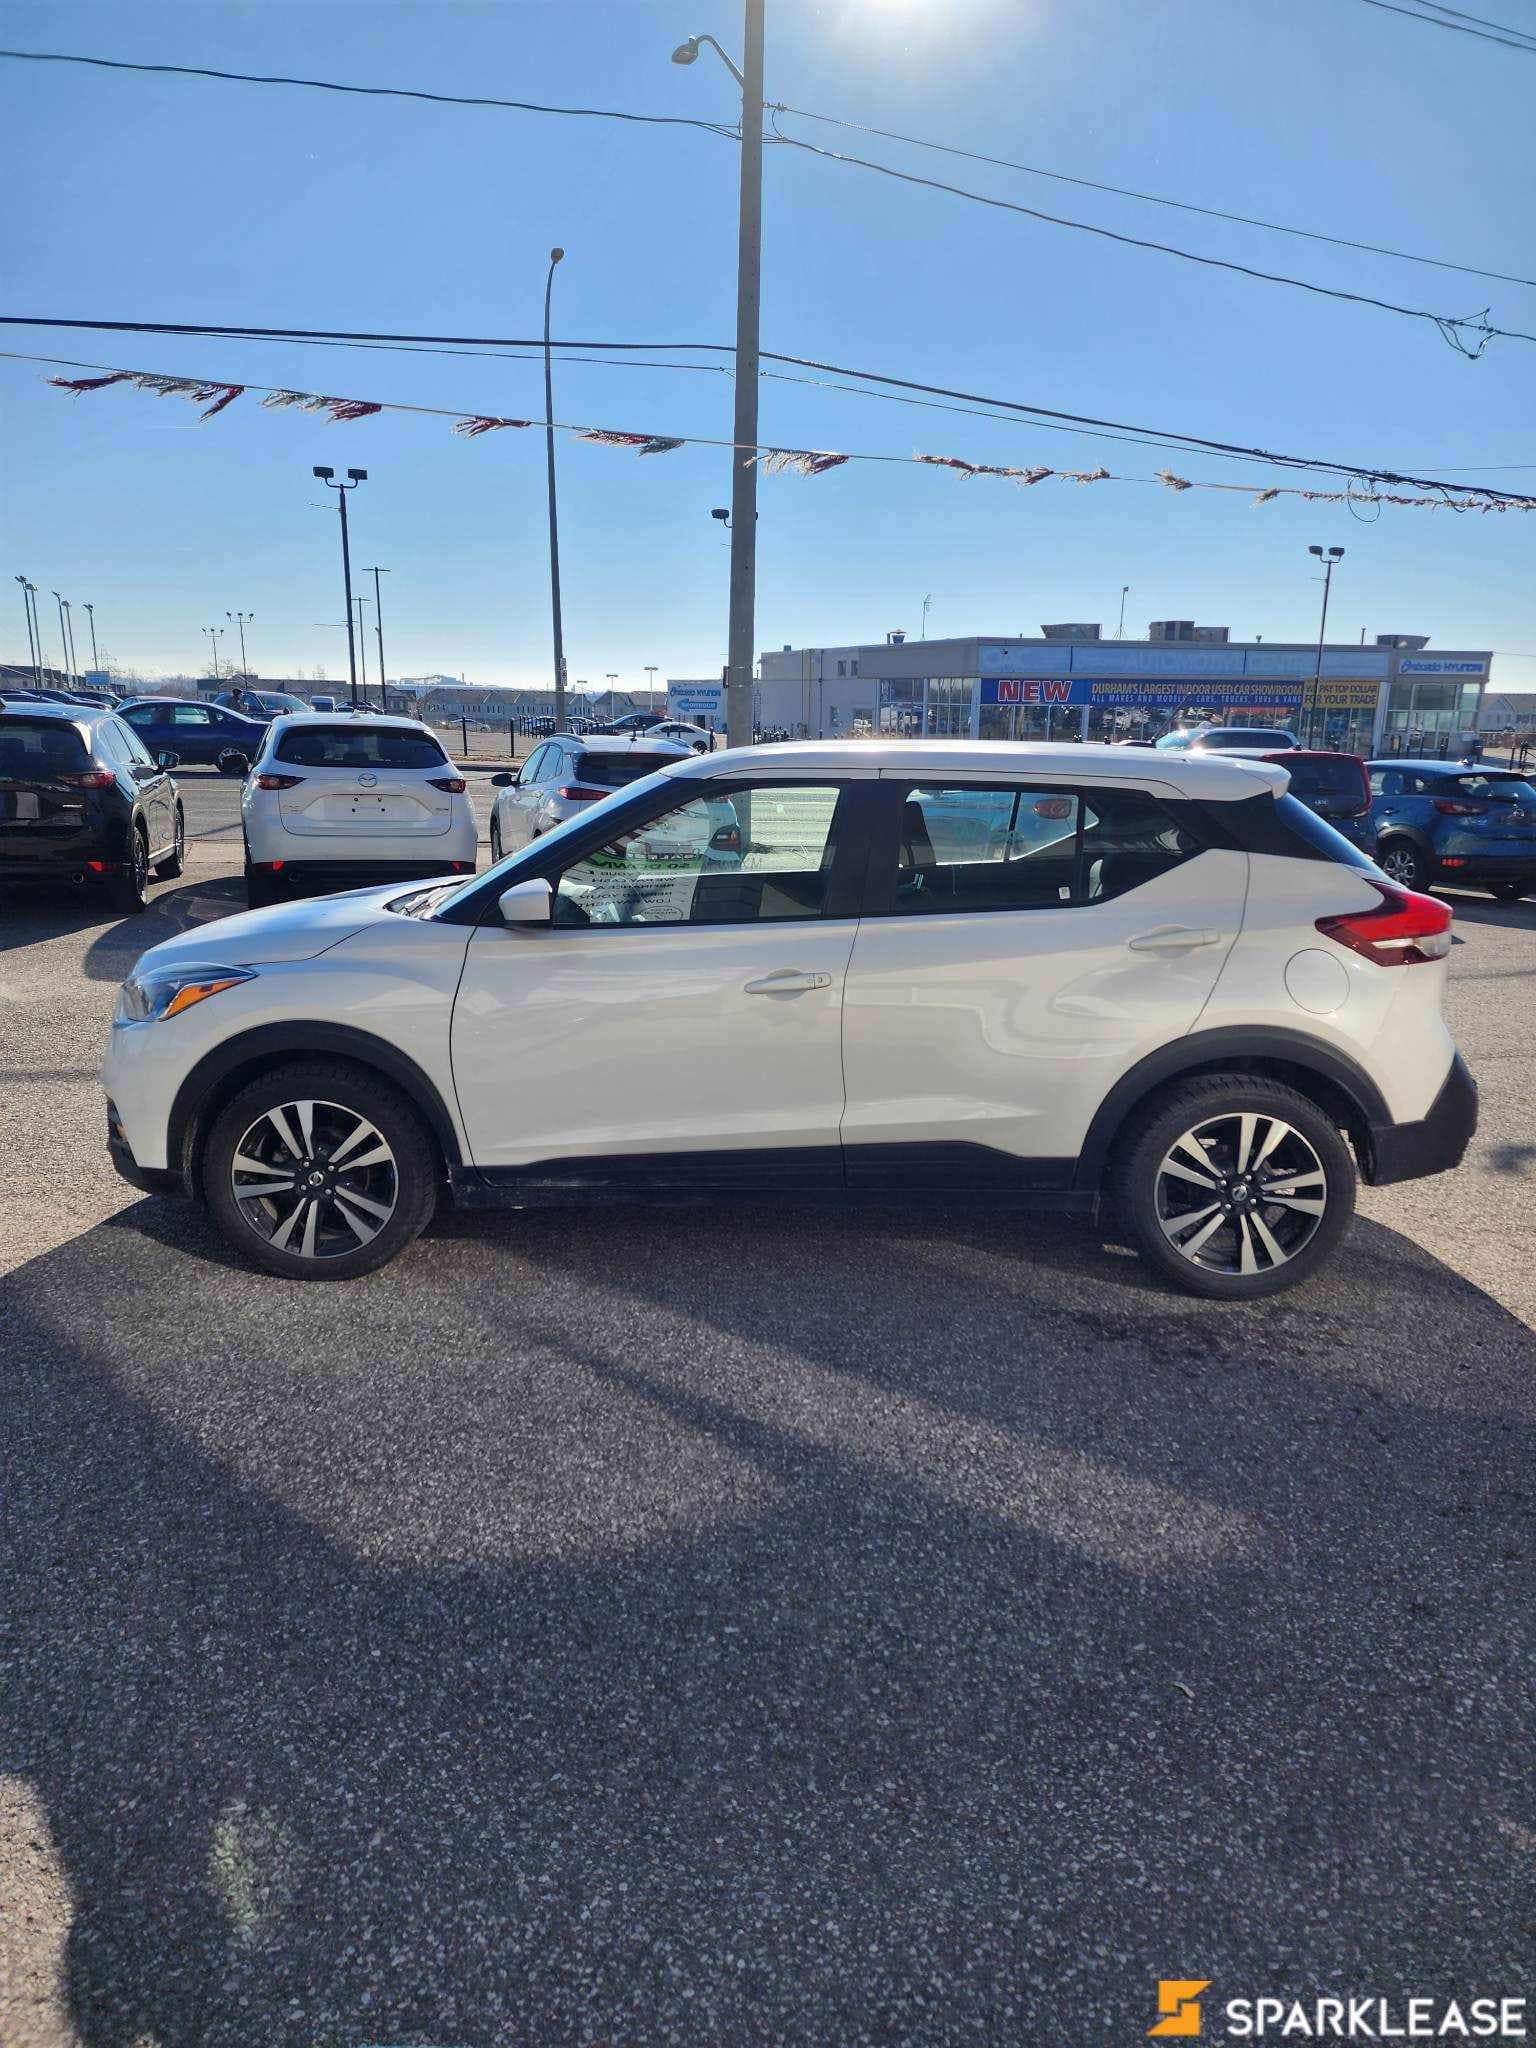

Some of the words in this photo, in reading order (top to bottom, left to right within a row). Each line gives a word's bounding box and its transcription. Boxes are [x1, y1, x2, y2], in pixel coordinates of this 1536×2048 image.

[998, 680, 1072, 702] NEW
[1139, 683, 1176, 694] LARGEST
[1212, 684, 1233, 695] USED
[1234, 684, 1250, 695] CAR
[1251, 684, 1302, 695] SHOWROOM
[1109, 694, 1134, 702] MAKES
[1138, 694, 1153, 702] AND
[1283, 695, 1302, 703] VANS
[1324, 694, 1348, 704] YOUR
[1349, 694, 1377, 704] TRADE
